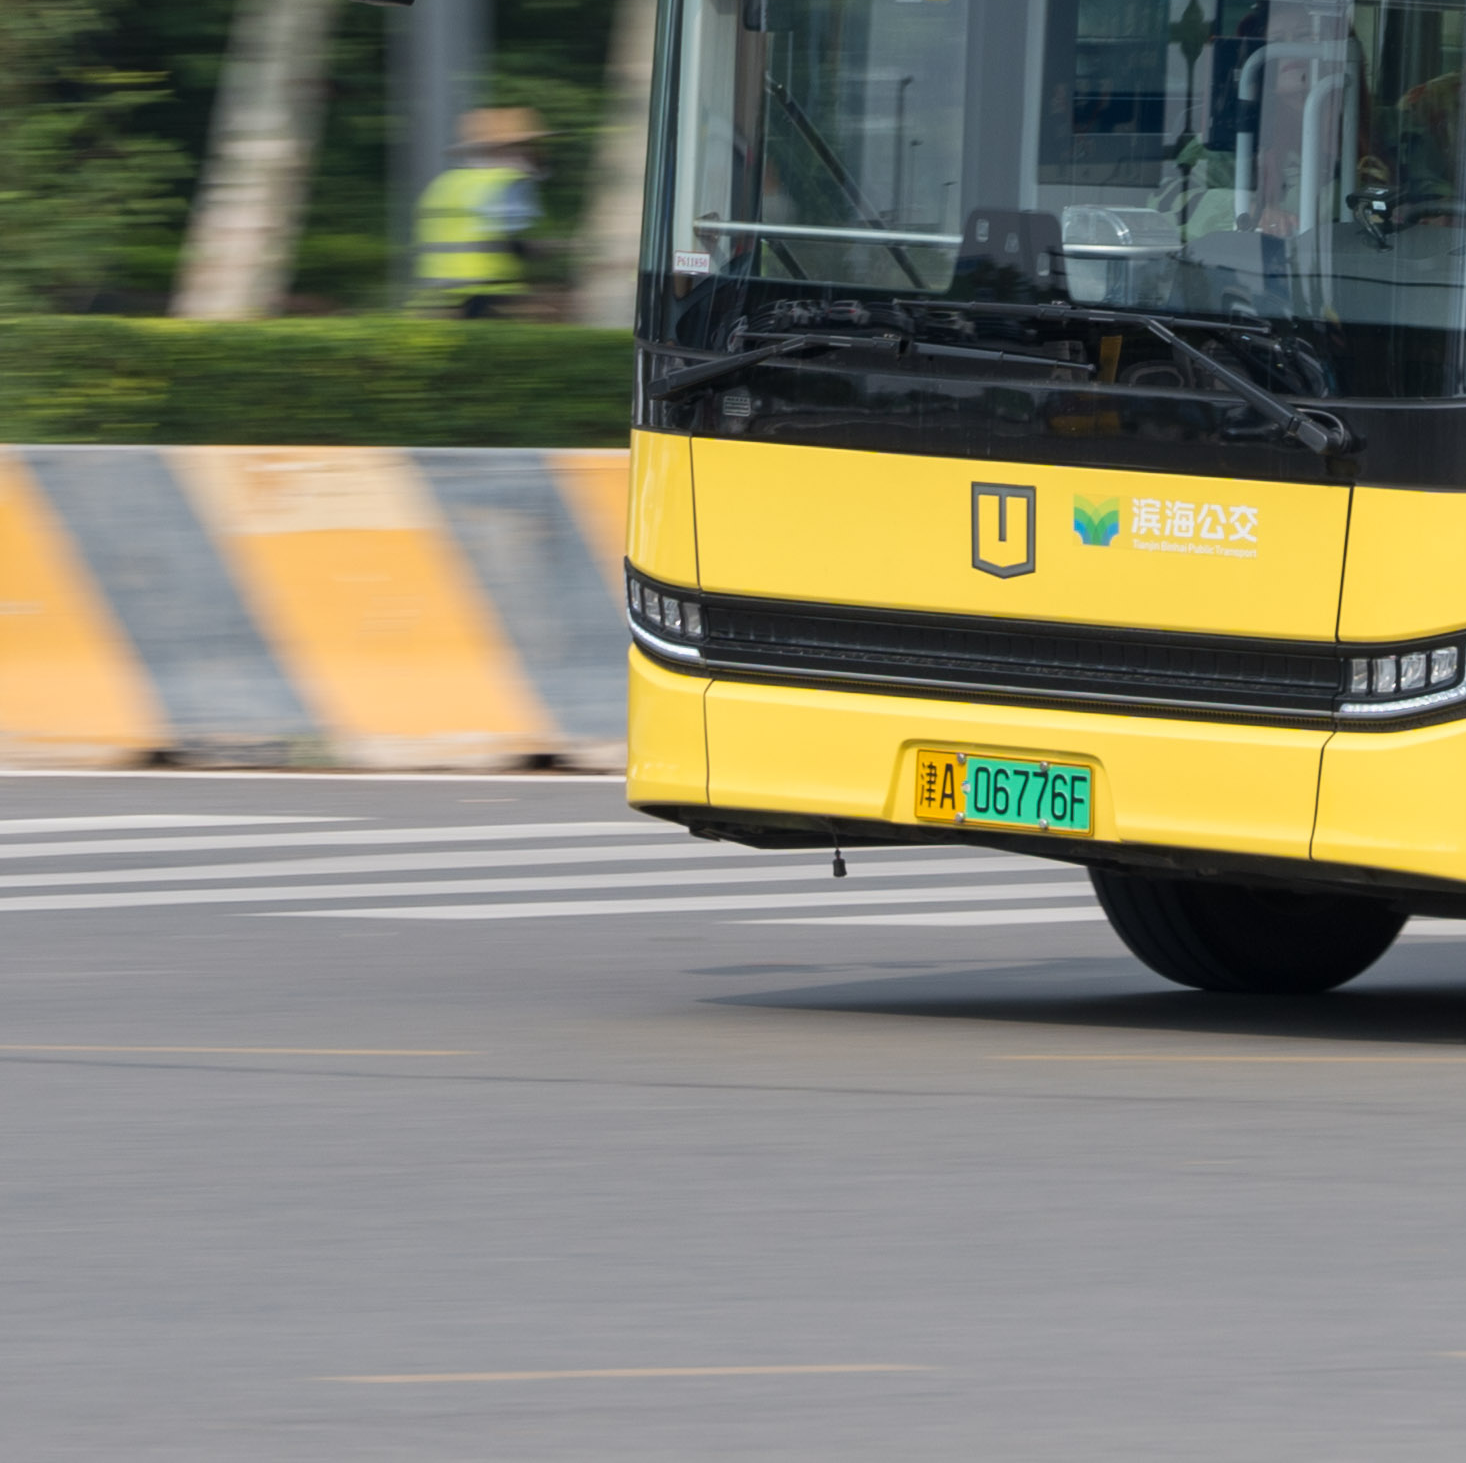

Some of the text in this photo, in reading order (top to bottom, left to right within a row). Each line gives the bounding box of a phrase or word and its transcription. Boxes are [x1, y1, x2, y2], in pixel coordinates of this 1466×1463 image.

[1131, 498, 1258, 542] 滨海公交
[1132, 538, 1257, 559] Tianjin Binhai Public Transport
